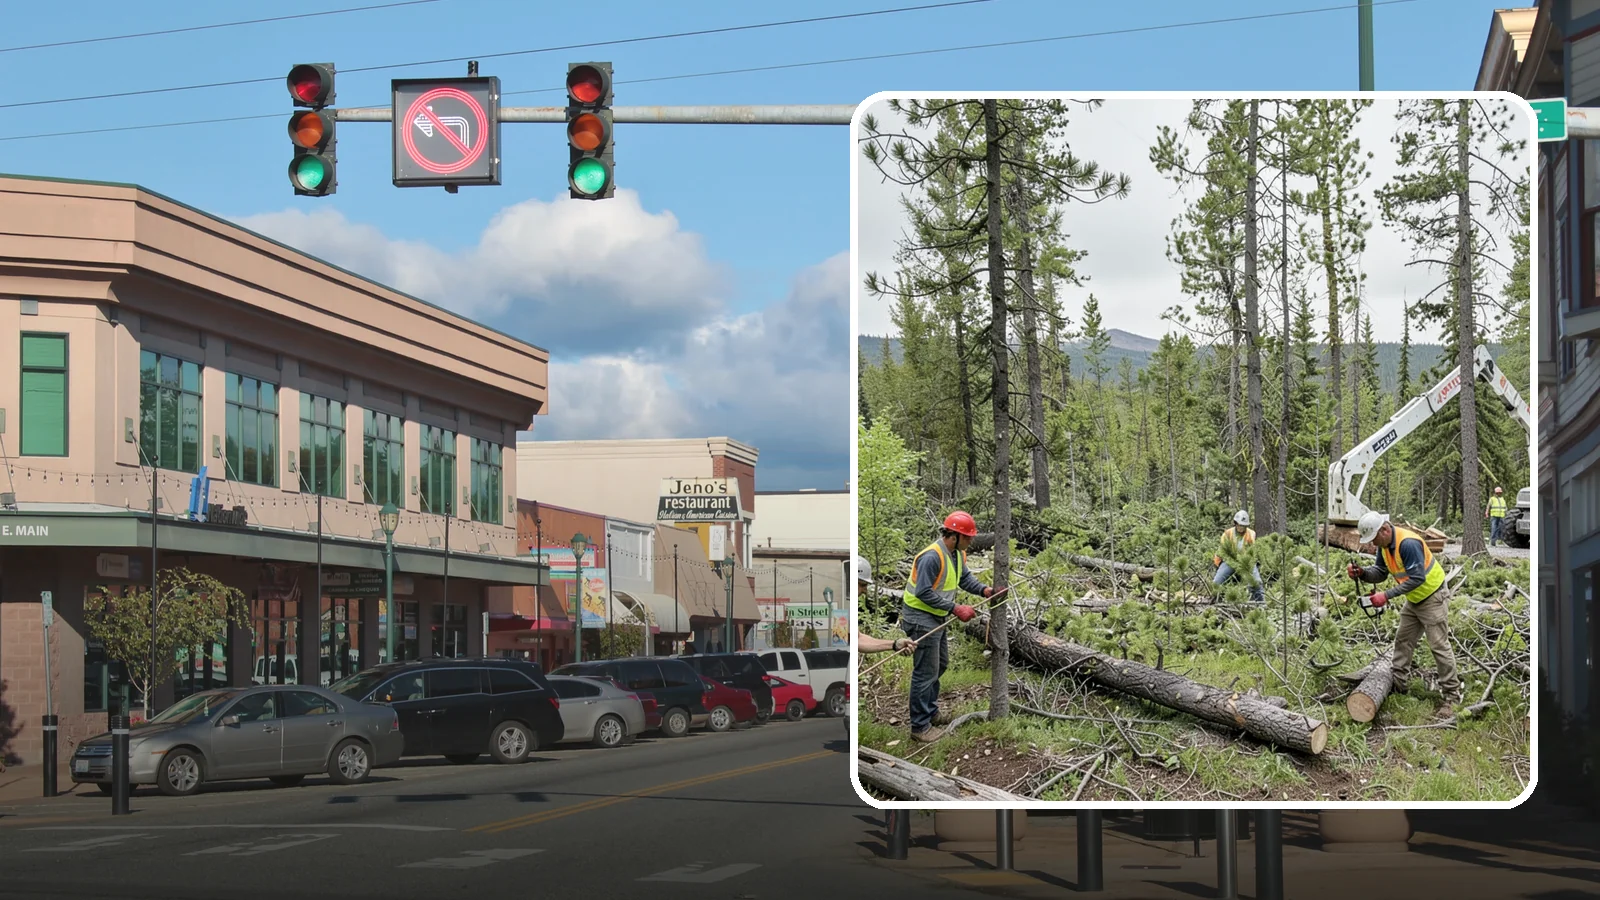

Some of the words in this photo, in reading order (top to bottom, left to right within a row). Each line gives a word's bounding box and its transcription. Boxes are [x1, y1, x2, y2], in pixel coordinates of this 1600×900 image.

[670, 480, 727, 494] Jeno's
[665, 497, 731, 509] restaurant
[658, 510, 681, 519] Italian
[686, 510, 714, 519] American
[715, 509, 737, 519] Cuisine
[2, 525, 13, 536] E.
[15, 525, 49, 536] MAIN
[797, 606, 828, 617] Street
